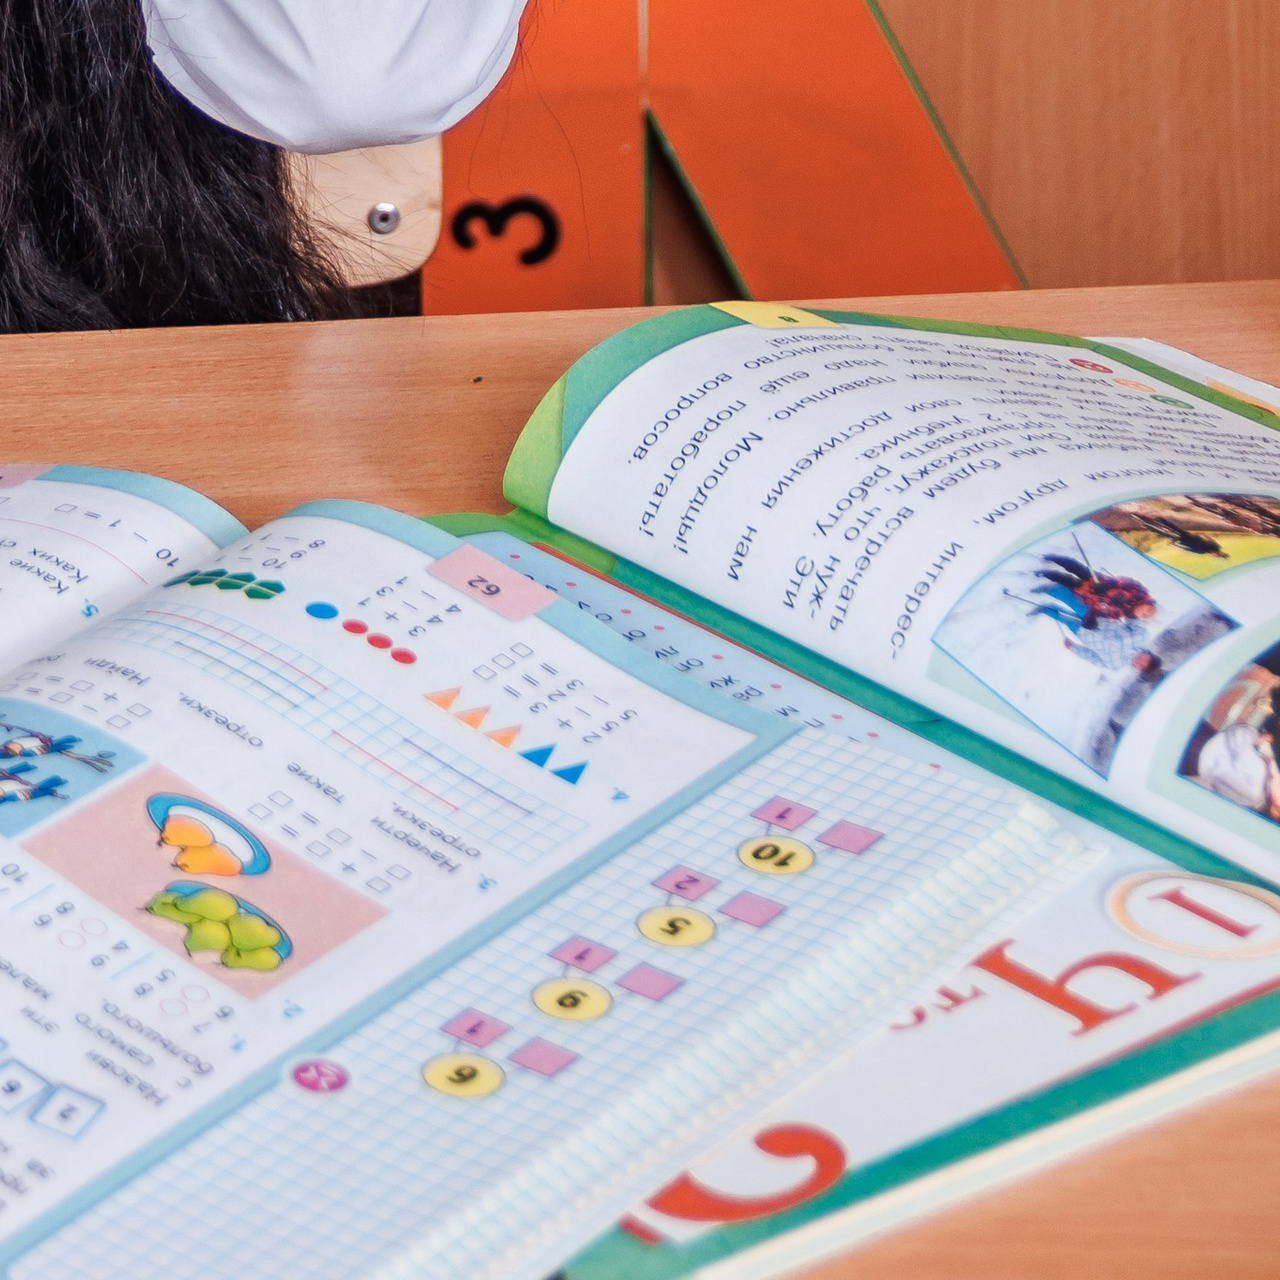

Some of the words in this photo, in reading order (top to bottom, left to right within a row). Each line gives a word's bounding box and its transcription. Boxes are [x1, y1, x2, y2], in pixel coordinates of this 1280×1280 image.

[451, 195, 562, 268] 3
[743, 344, 897, 372] большинство
[823, 357, 890, 372] Надо
[758, 370, 812, 396] ещё
[767, 374, 897, 422] правильно.
[626, 371, 734, 465] вопросов.
[903, 398, 964, 414] свои
[854, 413, 973, 462] учебника.
[898, 420, 1057, 464] организовать
[1007, 445, 1048, 460] мы
[637, 399, 748, 539] поработать!
[760, 410, 893, 510] достижения
[883, 436, 1014, 498] подскажут,
[922, 457, 1003, 501] будем
[671, 430, 765, 557] Молодцы!
[811, 463, 893, 539] работу.
[972, 477, 1070, 528] другом,
[842, 504, 883, 544] что
[26, 546, 90, 585] Каких
[155, 547, 181, 569] 10
[261, 557, 288, 571] 10
[726, 525, 758, 582] нам
[827, 505, 915, 632] встречать
[8, 558, 70, 596] Какие
[375, 585, 395, 598] 3
[467, 574, 501, 597] 62
[781, 554, 815, 610] Эти
[809, 553, 841, 620] нуж-
[425, 613, 444, 626] 4
[445, 603, 463, 616] 4
[890, 540, 965, 661] интерес-
[407, 625, 427, 638] 3
[83, 656, 152, 687] Найди
[565, 678, 586, 692] 3
[528, 700, 548, 715] 3
[547, 689, 567, 703] 2
[618, 708, 638, 722] 5
[178, 691, 265, 749] отрезки.
[581, 730, 601, 745] 2
[599, 719, 620, 733] 5
[286, 761, 346, 806] такие
[370, 814, 464, 874] Начерти
[392, 801, 482, 860] отрезки.
[751, 843, 797, 869] 10
[673, 874, 700, 891] 2
[659, 917, 692, 937] 5
[19, 1004, 62, 1033] эти
[74, 1013, 155, 1069] самого
[83, 1049, 166, 1107] Назови
